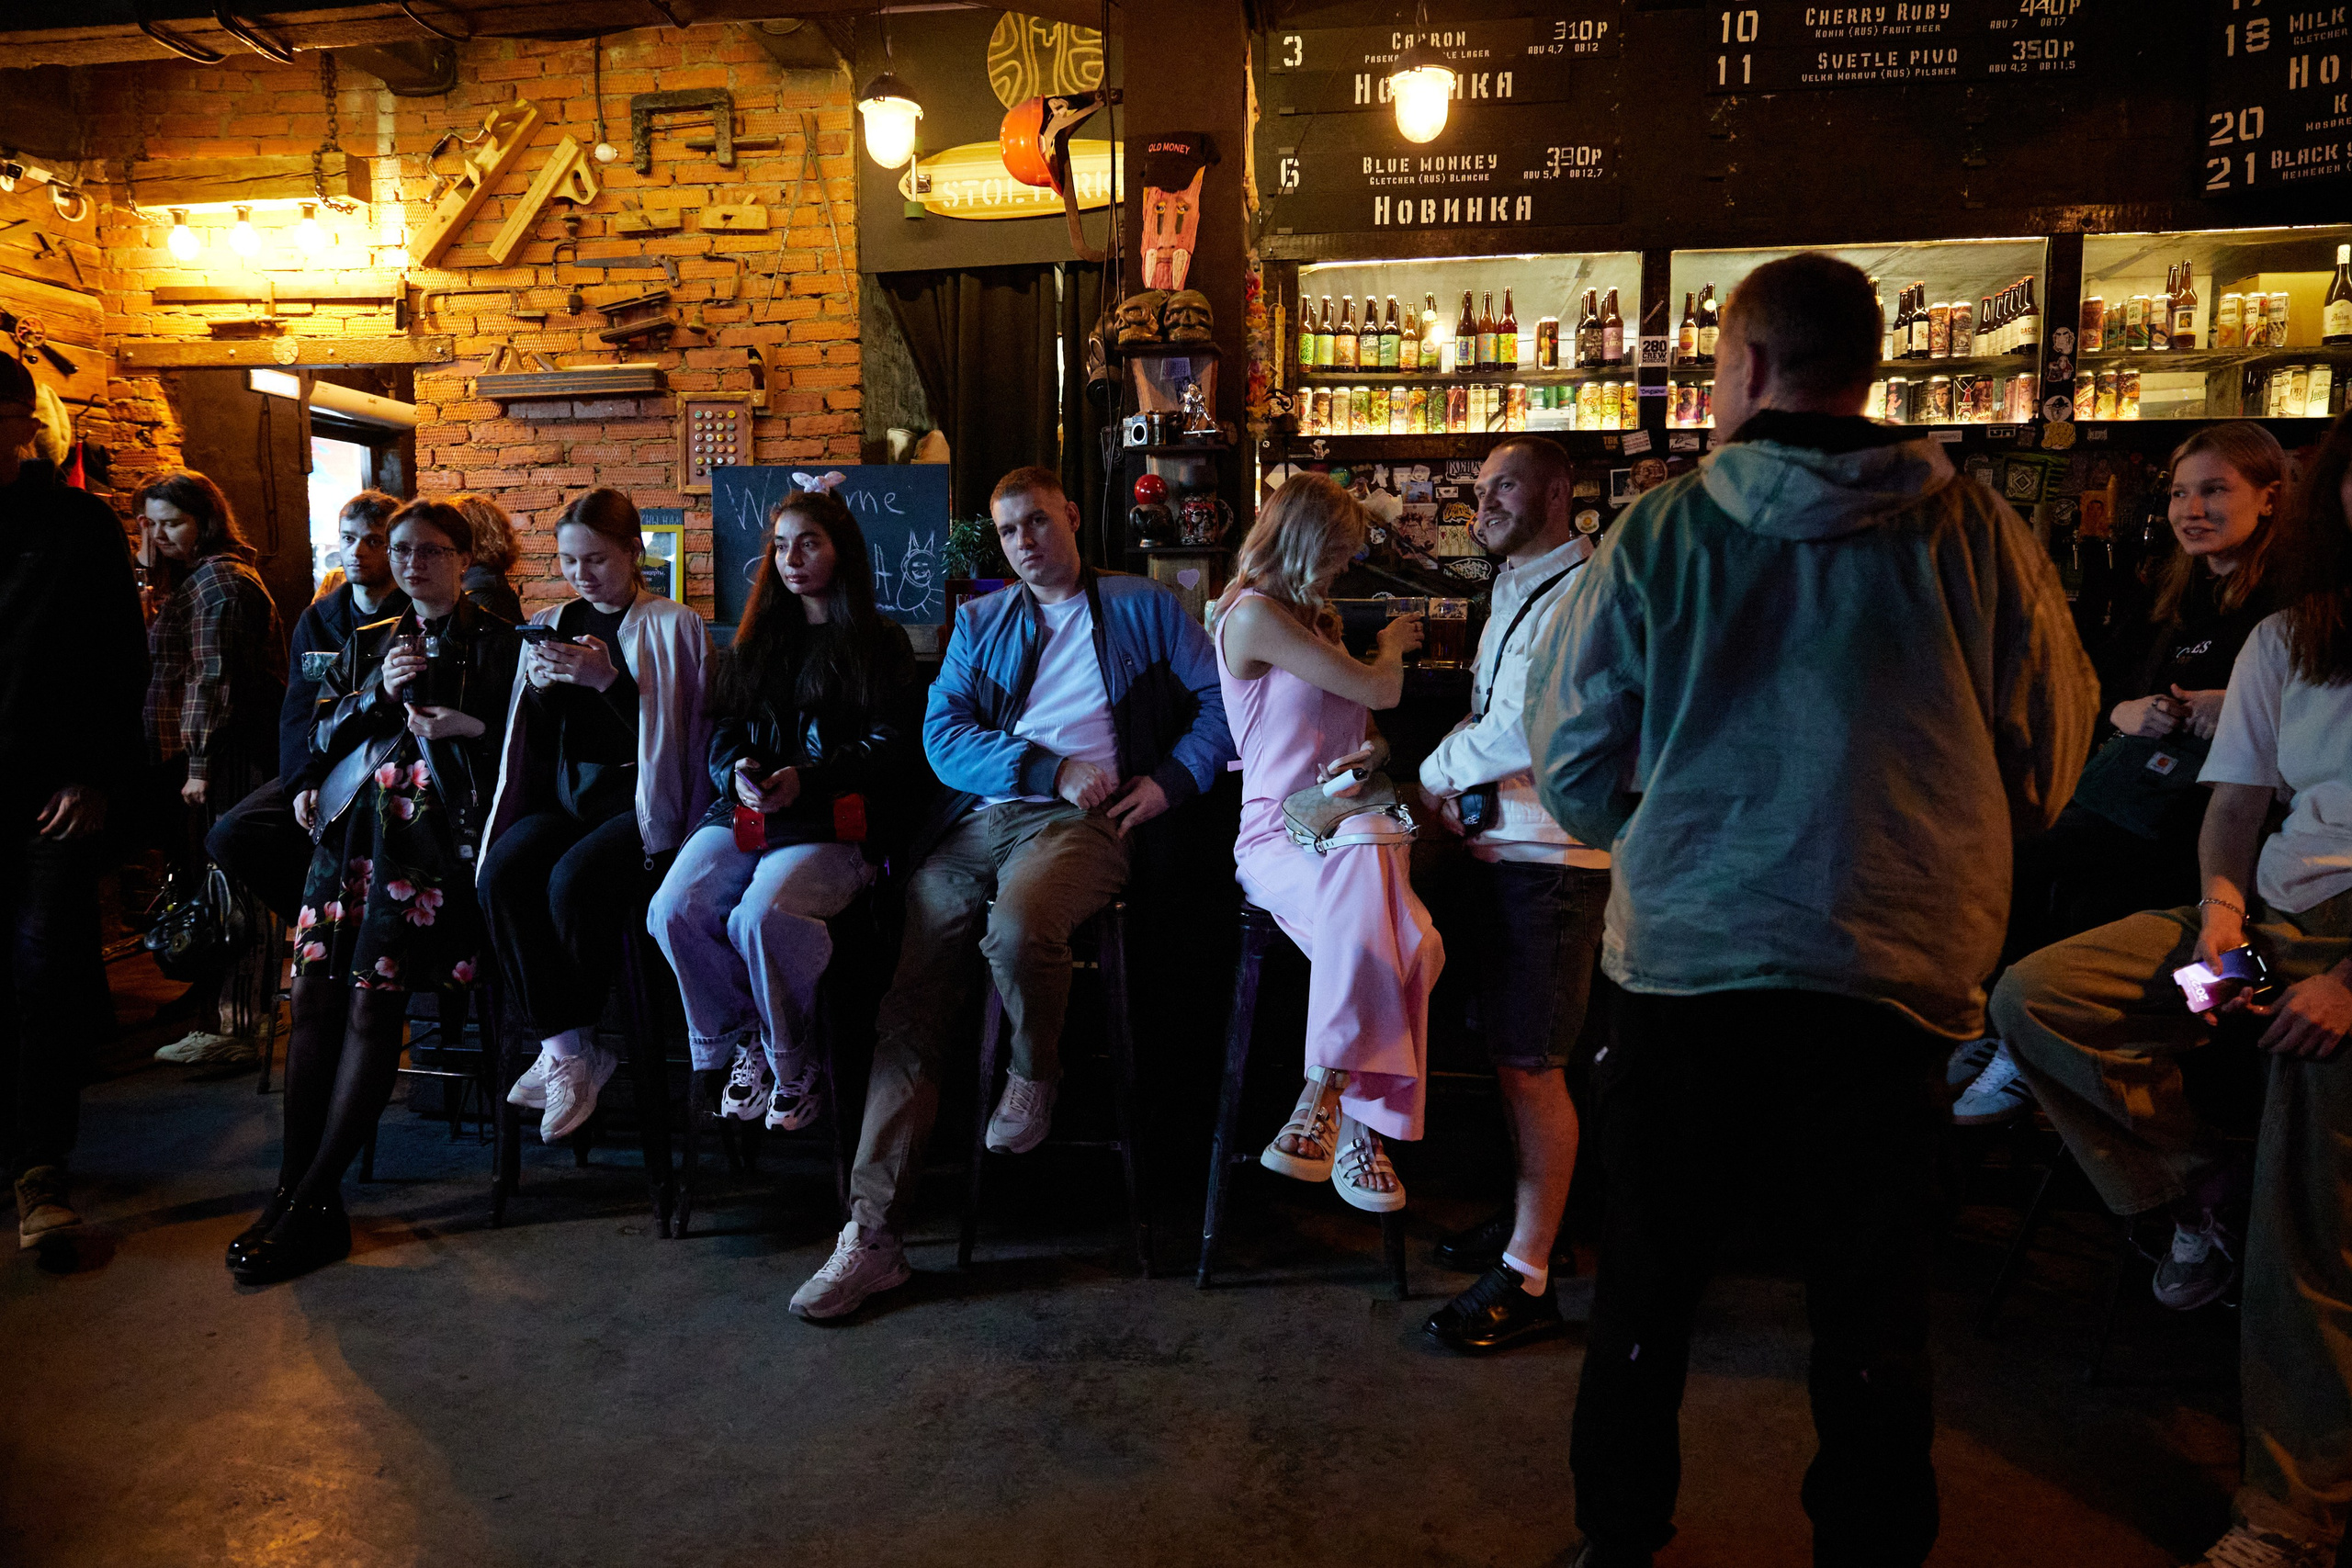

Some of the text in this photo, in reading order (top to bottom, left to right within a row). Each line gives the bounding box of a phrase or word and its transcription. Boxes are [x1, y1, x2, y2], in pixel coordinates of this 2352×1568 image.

[1722, 10, 1758, 43] 10
[1805, 3, 1951, 27] CHERRY RUBY
[2011, 18, 2018, 28] 7
[2290, 6, 2346, 35] MILK
[1849, 26, 1879, 38] (RUS)
[1883, 25, 1912, 35] FRUIT
[1916, 24, 1941, 33] BEER
[2225, 17, 2270, 57] 18
[2293, 27, 2348, 46] GLETCHER
[1283, 36, 1302, 67] 3
[1461, 49, 1490, 59] LAGER
[1817, 48, 1958, 70] SVETLE PIVO
[1717, 54, 1750, 85] 11
[1802, 67, 1957, 83] VELKA MORAVA (RUS) PILSNER
[2209, 106, 2265, 147] 20
[1148, 141, 1191, 155] OLD MONEY
[2271, 143, 2339, 171] BLACK
[1280, 158, 1300, 187] 6
[1363, 154, 1498, 175] BLUE MONKEY
[2206, 152, 2256, 191] 21
[2282, 164, 2340, 181] HEINEKEN
[1370, 173, 1489, 186] GLETCHER (RUS) BLANCHE
[1375, 196, 1532, 225] НОВИНКА
[1643, 340, 1667, 353] 280
